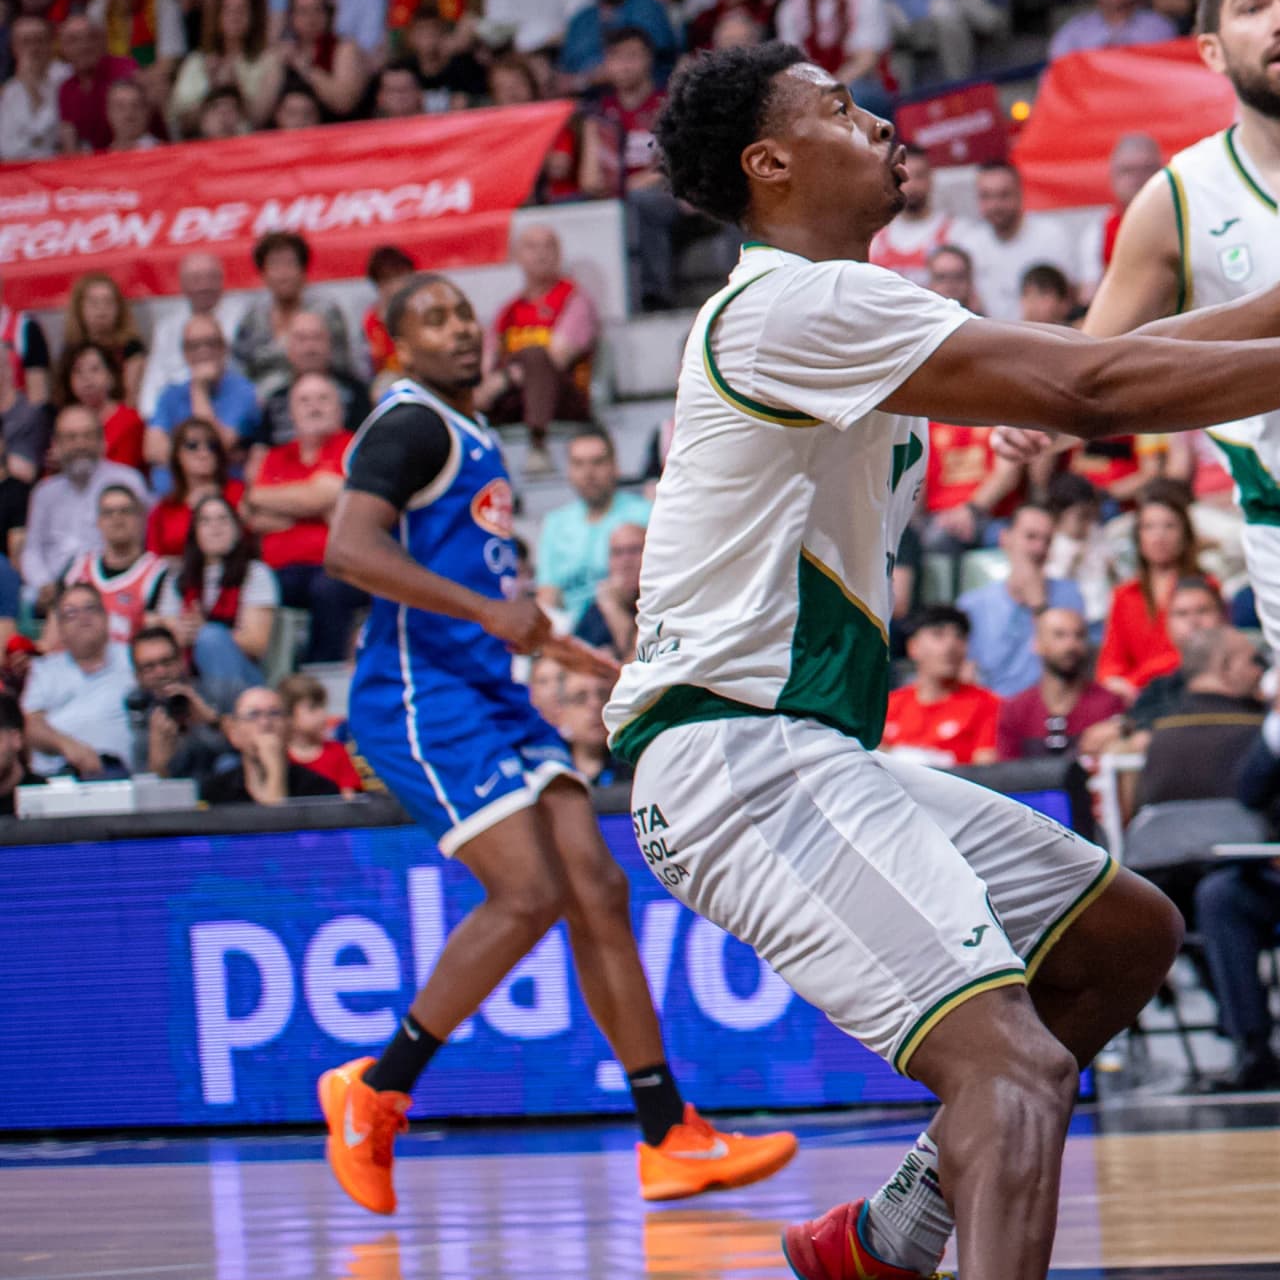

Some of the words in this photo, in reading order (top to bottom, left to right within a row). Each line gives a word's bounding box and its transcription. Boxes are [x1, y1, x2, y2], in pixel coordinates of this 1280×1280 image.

[169, 202, 249, 245] DE
[253, 177, 473, 239] MURCIA
[643, 837, 678, 865] SOL
